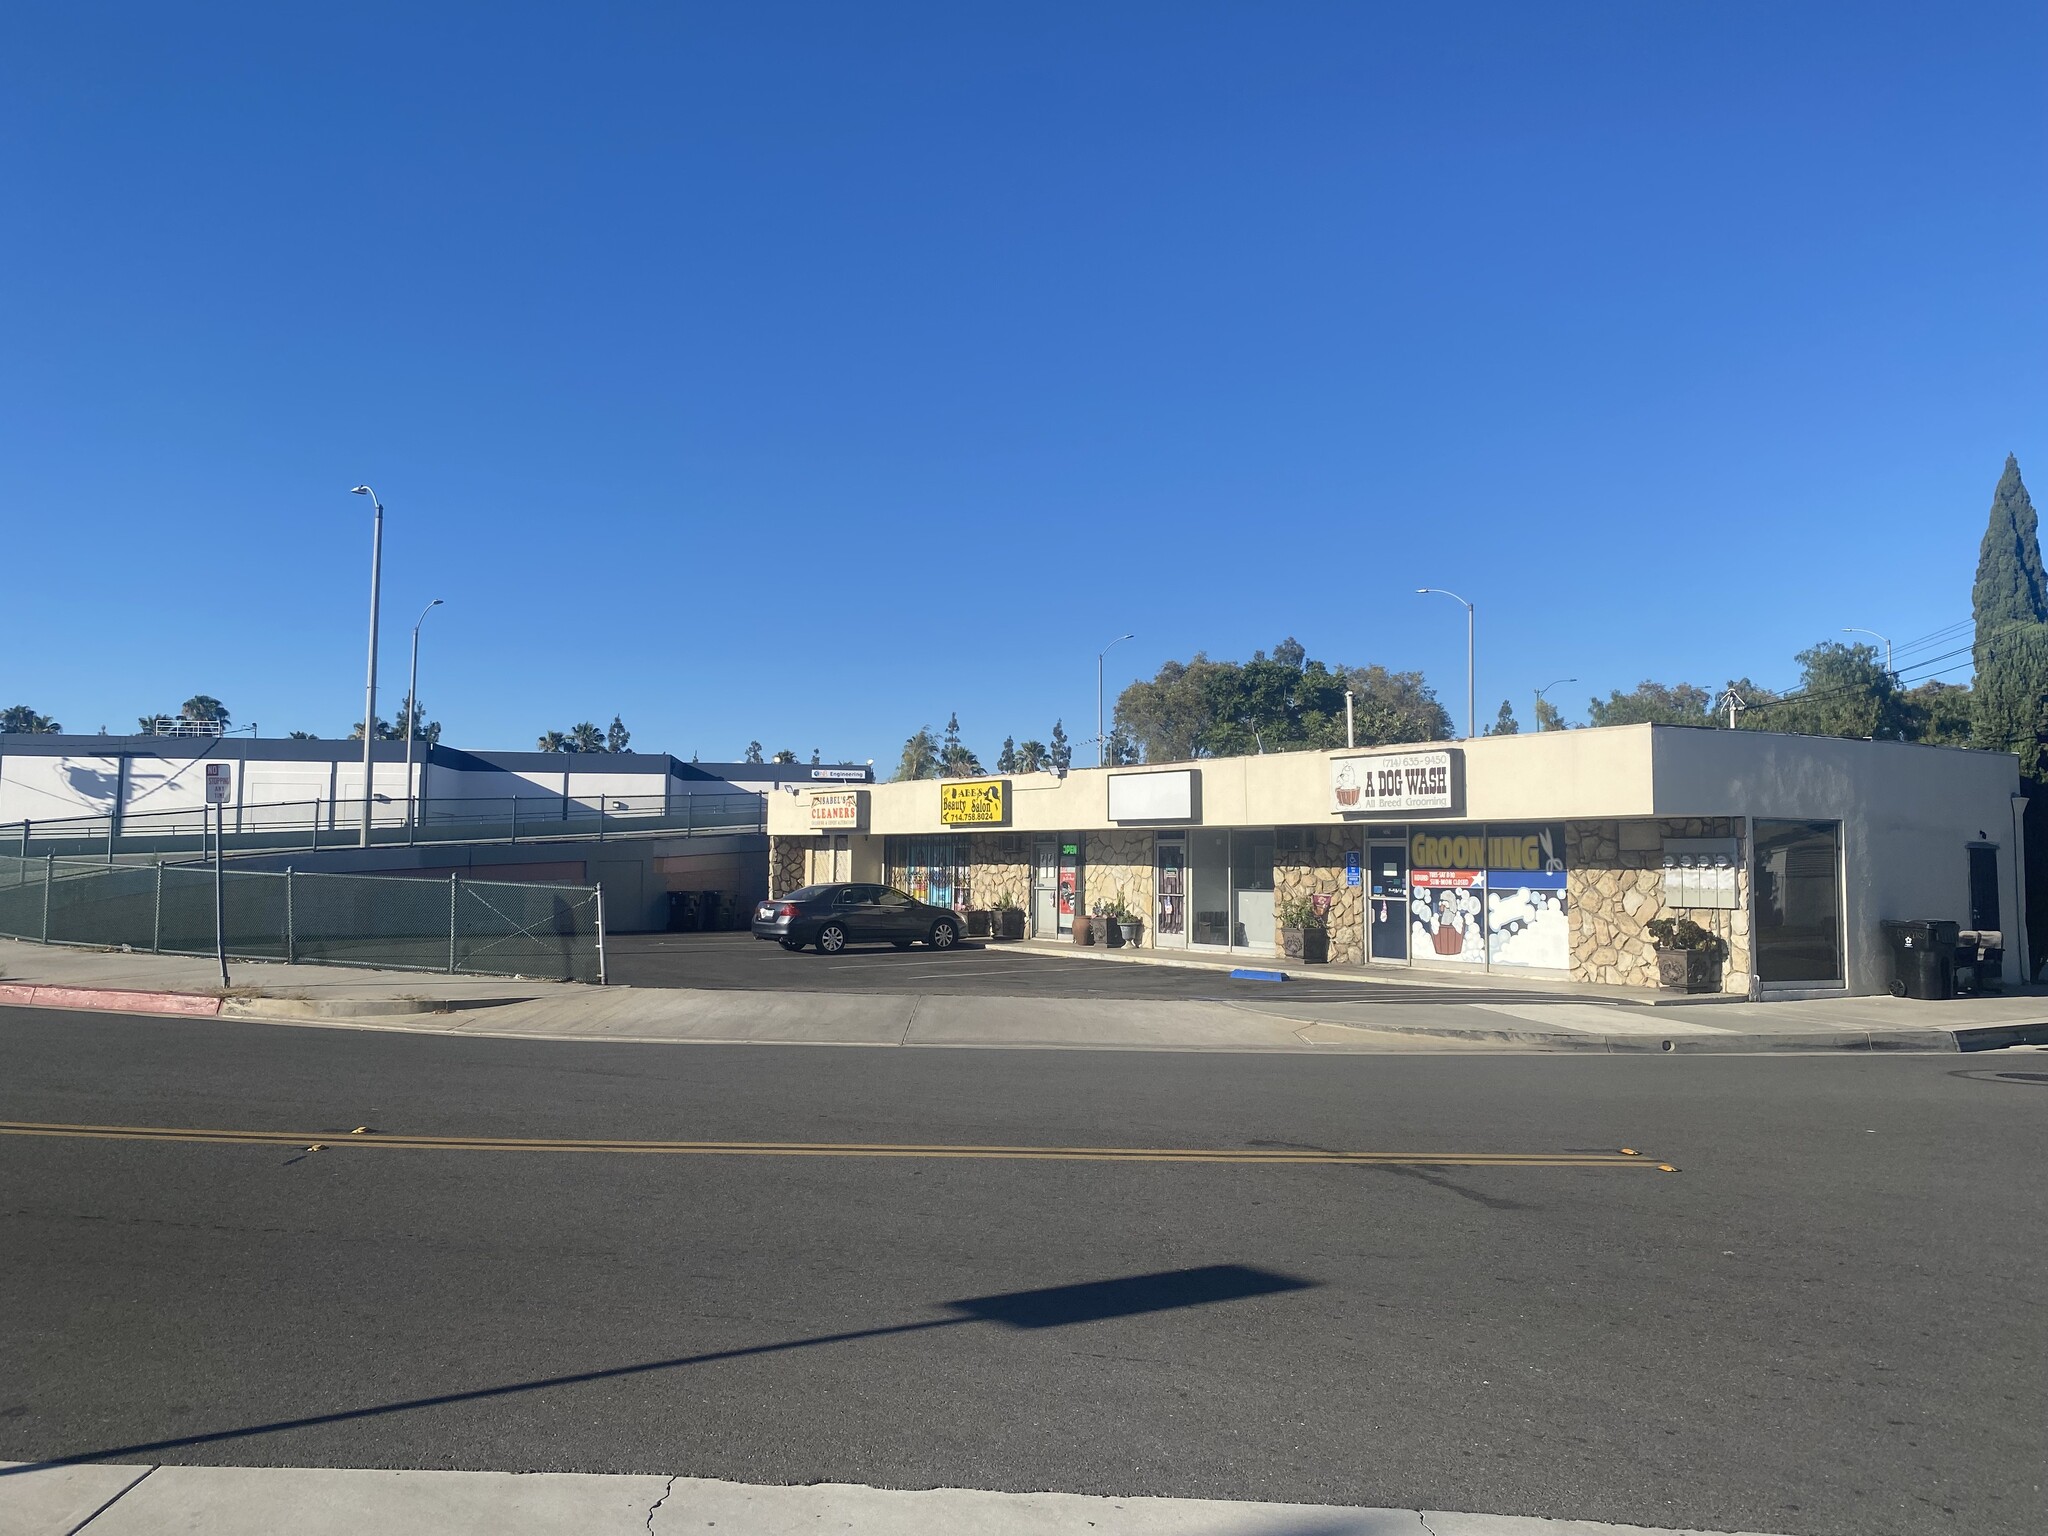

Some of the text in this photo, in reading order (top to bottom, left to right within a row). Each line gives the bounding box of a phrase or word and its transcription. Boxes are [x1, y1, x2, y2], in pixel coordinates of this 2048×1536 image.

[1383, 755, 1447, 768] (714) 635-9450
[208, 766, 217, 775] NO
[1365, 767, 1447, 798] A DOG WASH
[819, 795, 846, 805] ISABEL'S
[943, 797, 991, 814] Beauty Salon
[1366, 797, 1447, 808] All Breed Grooming
[811, 807, 855, 819] CLEANERS
[1063, 845, 1077, 854] OPEN
[1412, 832, 1540, 870] GROOMING
[1452, 878, 1469, 886] CLOSED
